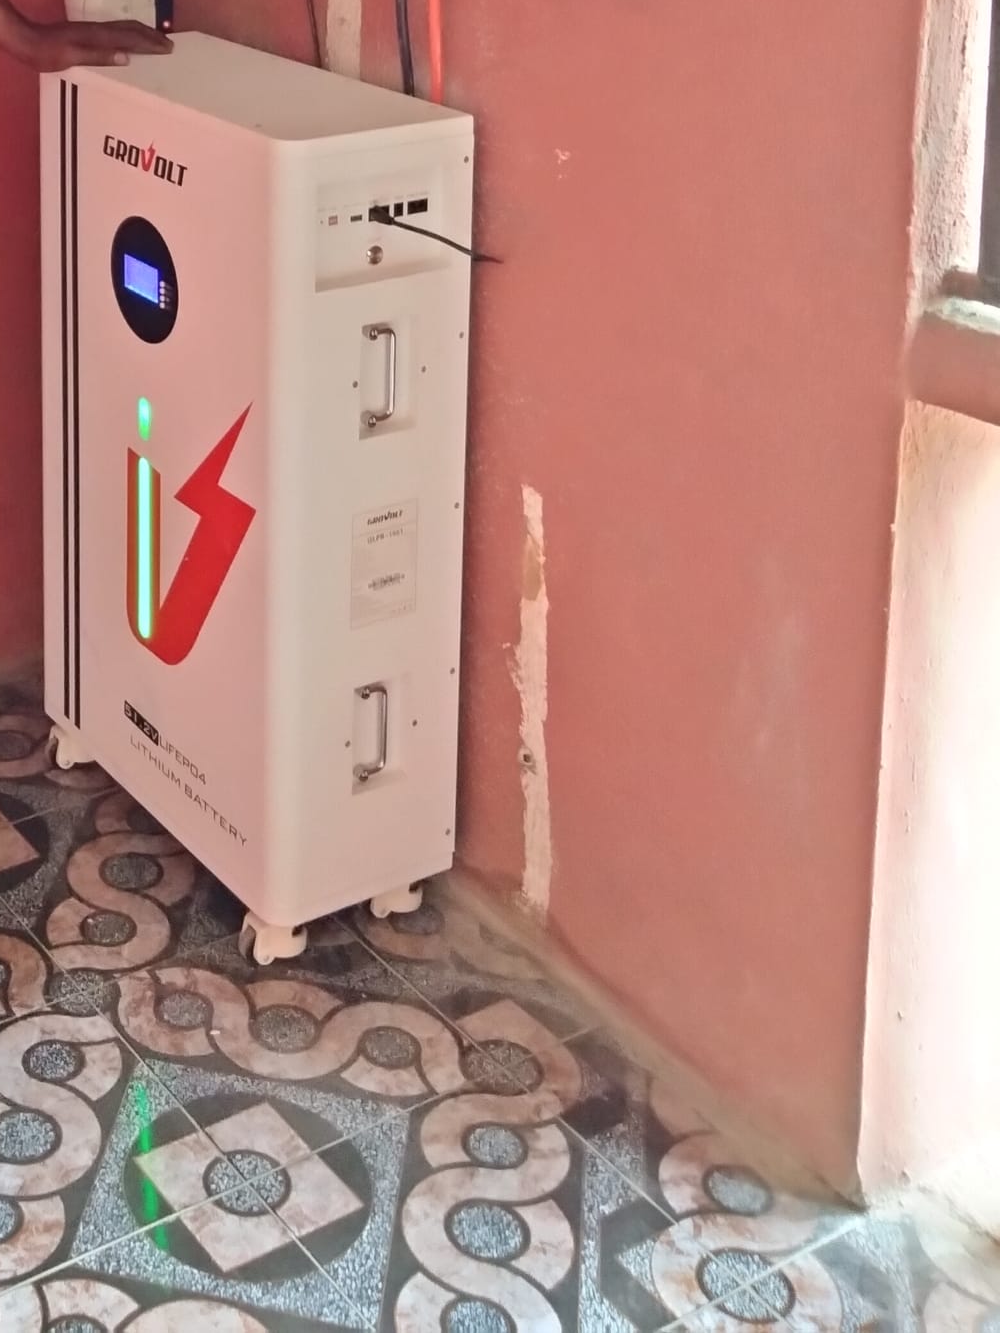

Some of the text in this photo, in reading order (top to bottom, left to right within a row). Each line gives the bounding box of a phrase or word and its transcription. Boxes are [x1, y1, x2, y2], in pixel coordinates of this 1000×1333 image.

[103, 134, 188, 187] GROVOLT
[124, 701, 159, 745] 51.2V
[130, 733, 248, 847] LITHIUM BATTERY
